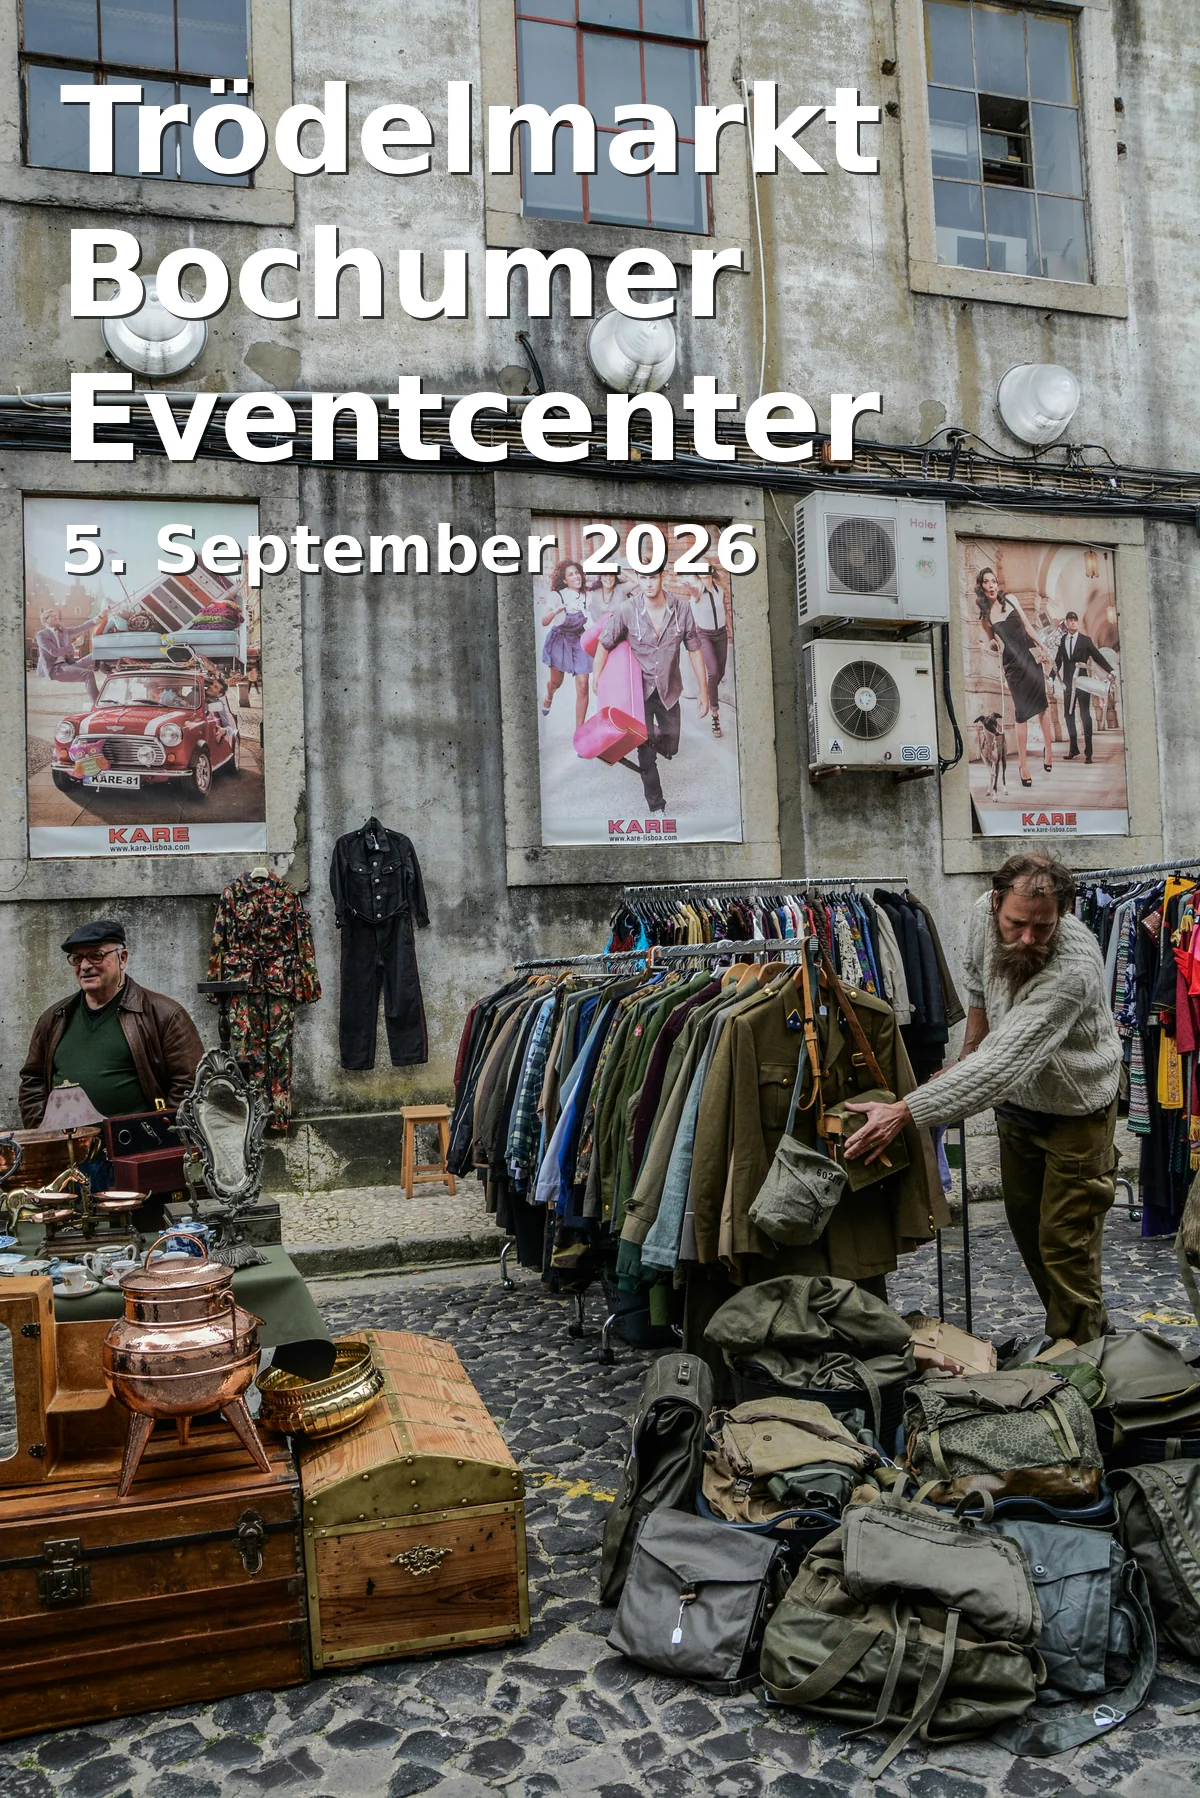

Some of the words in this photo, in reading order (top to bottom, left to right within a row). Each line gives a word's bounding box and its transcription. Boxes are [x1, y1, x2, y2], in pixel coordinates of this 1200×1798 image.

[910, 518, 938, 530] Haier
[91, 774, 138, 785] KARE-81
[1021, 812, 1077, 826] KARE
[608, 819, 677, 834] KARE
[108, 827, 190, 844] KARE
[609, 834, 678, 842] www.kare-lisboa.com
[109, 843, 190, 852] www.kare-lisboa.com
